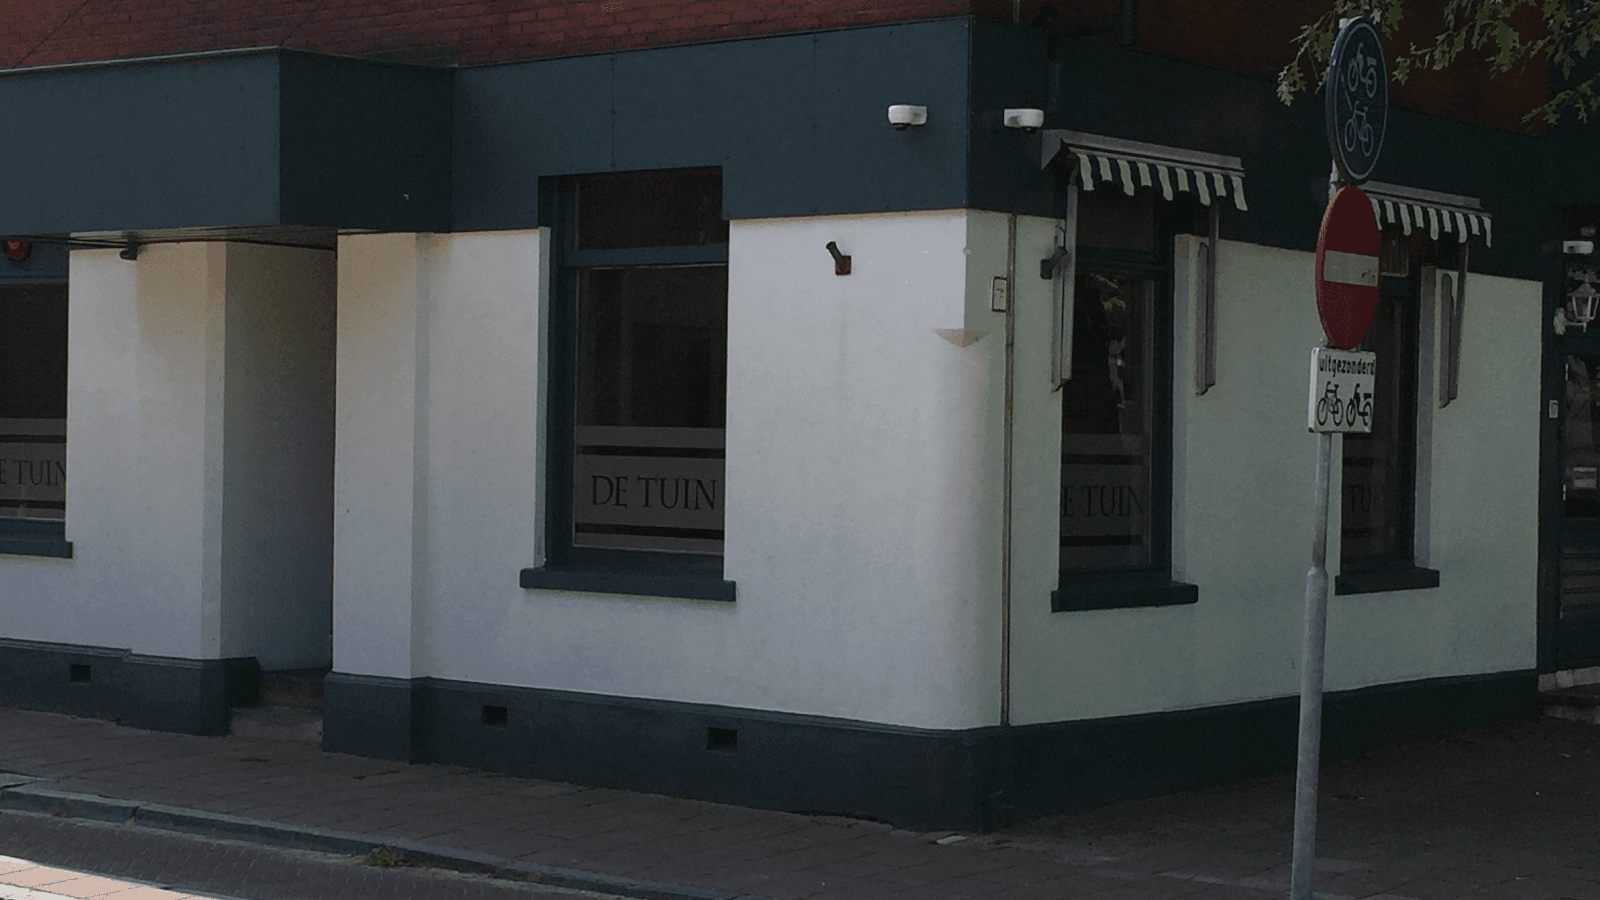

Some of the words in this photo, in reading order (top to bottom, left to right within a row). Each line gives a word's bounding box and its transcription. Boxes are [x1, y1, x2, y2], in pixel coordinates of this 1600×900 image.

[1319, 354, 1376, 378] uitgezonderd
[0, 458, 7, 487] E
[591, 475, 628, 510] DE
[637, 475, 718, 511] TUIN
[1061, 484, 1074, 518] E
[1081, 484, 1144, 518] TUIN
